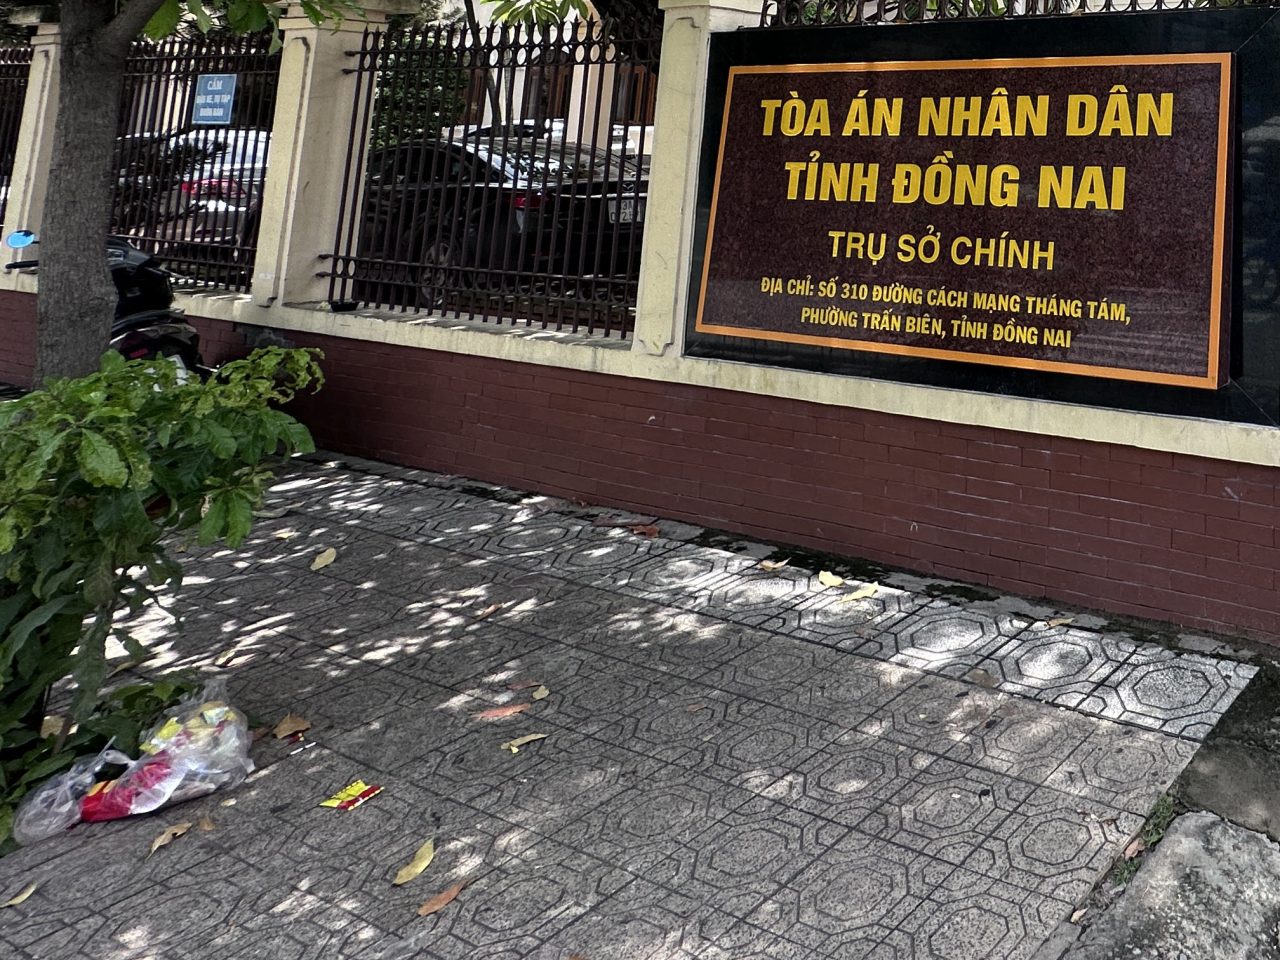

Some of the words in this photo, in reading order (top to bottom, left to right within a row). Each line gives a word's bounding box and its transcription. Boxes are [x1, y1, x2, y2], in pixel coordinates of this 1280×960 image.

[761, 90, 831, 137] TÒA
[842, 89, 903, 137] ÁN
[918, 87, 1049, 137] NHÂN
[1066, 84, 1174, 137] DÂN
[785, 150, 879, 203] TỈNH
[892, 150, 1020, 208] ĐỒNG
[1038, 166, 1126, 211] NAI
[828, 230, 887, 266] TRỤ
[897, 224, 941, 265] SỞ
[951, 231, 1055, 271] CHÍNH
[760, 276, 783, 295] ĐỊA
[787, 275, 814, 298] CHỈ:
[818, 276, 838, 300] SỐ
[841, 283, 869, 301] 310
[872, 283, 923, 305] ĐƯỜNG
[926, 288, 968, 309] CÁCH
[972, 292, 1020, 314] MẠNG
[1025, 295, 1083, 318] THÁNG
[1086, 298, 1131, 325] TÁM,
[800, 306, 858, 328] PHƯỜNG
[862, 309, 902, 332] TRẤN
[905, 314, 946, 339] BIÊN,
[951, 318, 988, 340] TỈNH
[992, 317, 1039, 345] ĐỒNG
[1043, 328, 1072, 349] NAI
